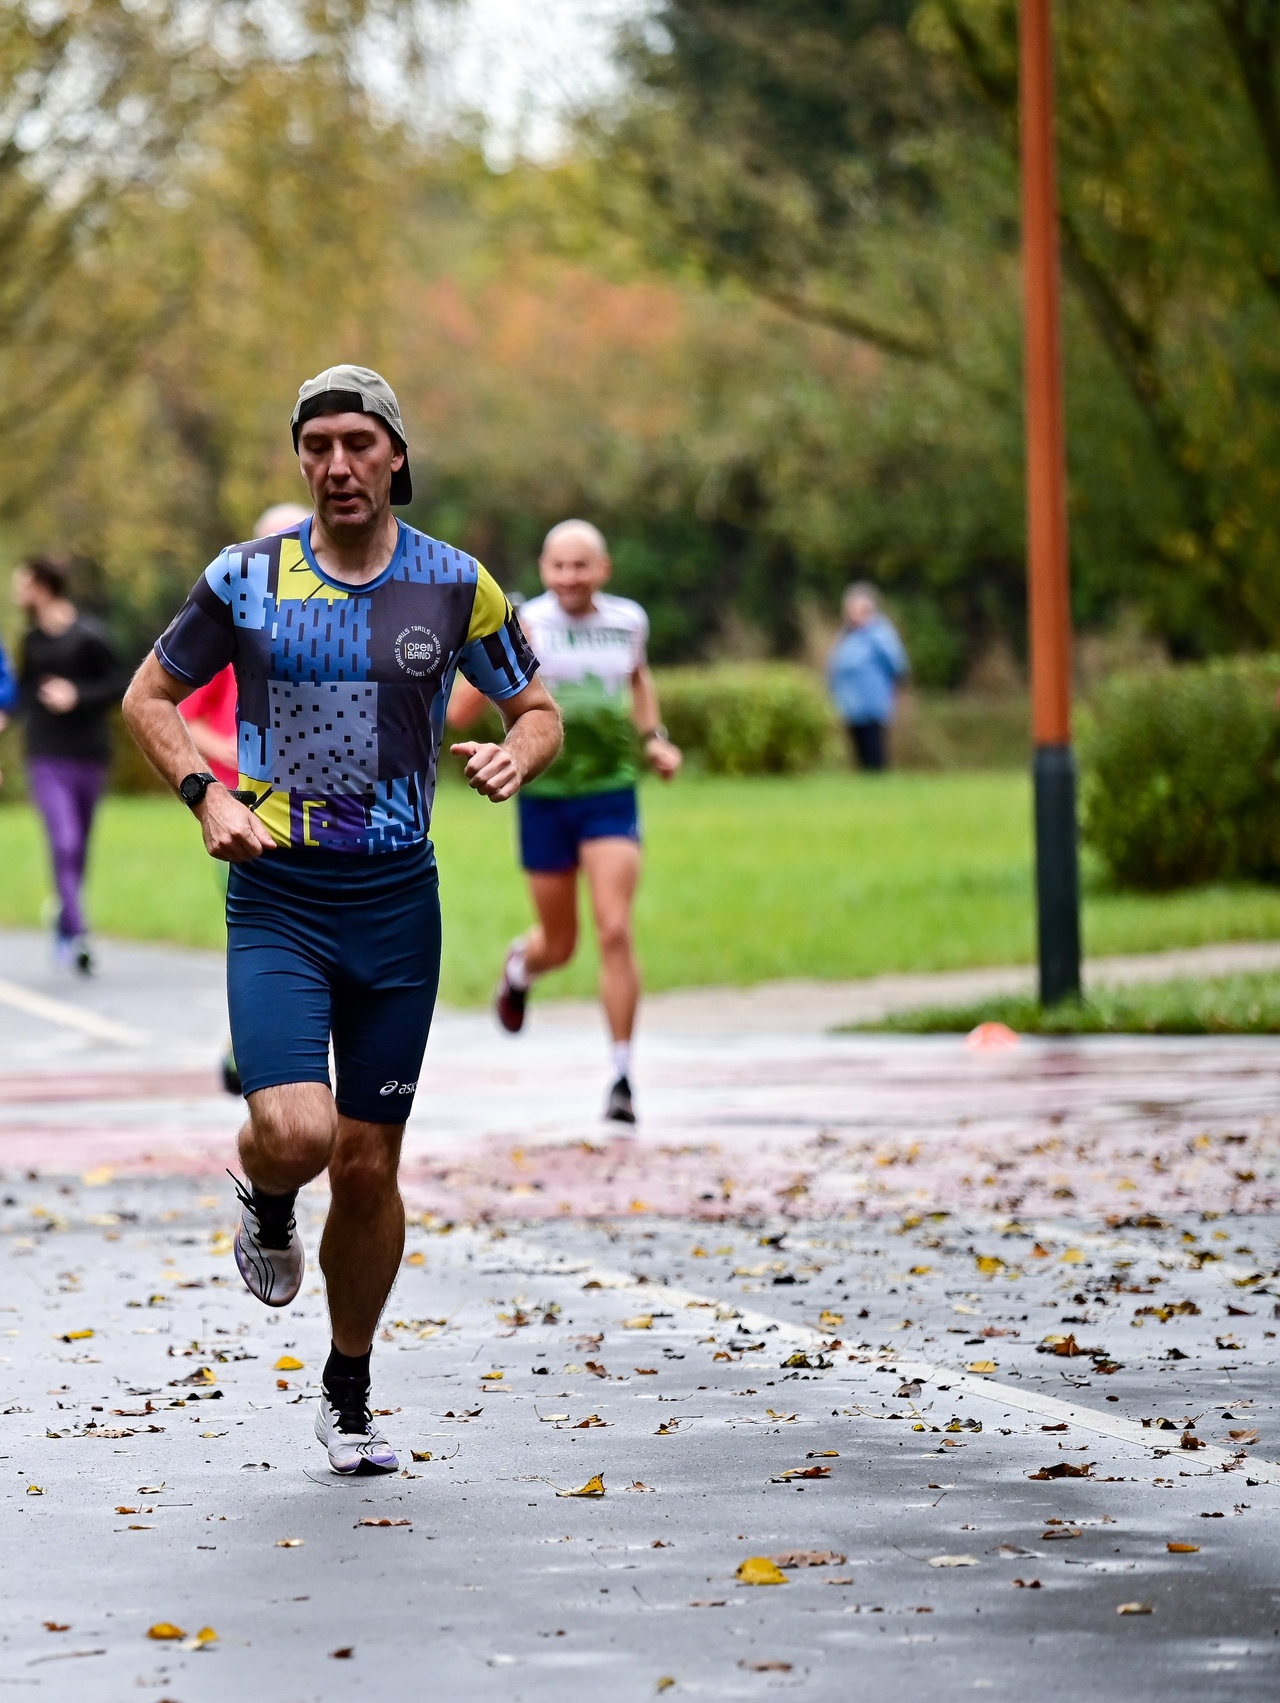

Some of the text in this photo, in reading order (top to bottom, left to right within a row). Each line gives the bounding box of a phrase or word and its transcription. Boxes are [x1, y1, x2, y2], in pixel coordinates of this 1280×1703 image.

[395, 628, 410, 645] TRAILS
[411, 626, 431, 635] TRAILS
[431, 634, 441, 654] TRAILS
[395, 648, 405, 669] TRAILS
[407, 651, 431, 660] BAND
